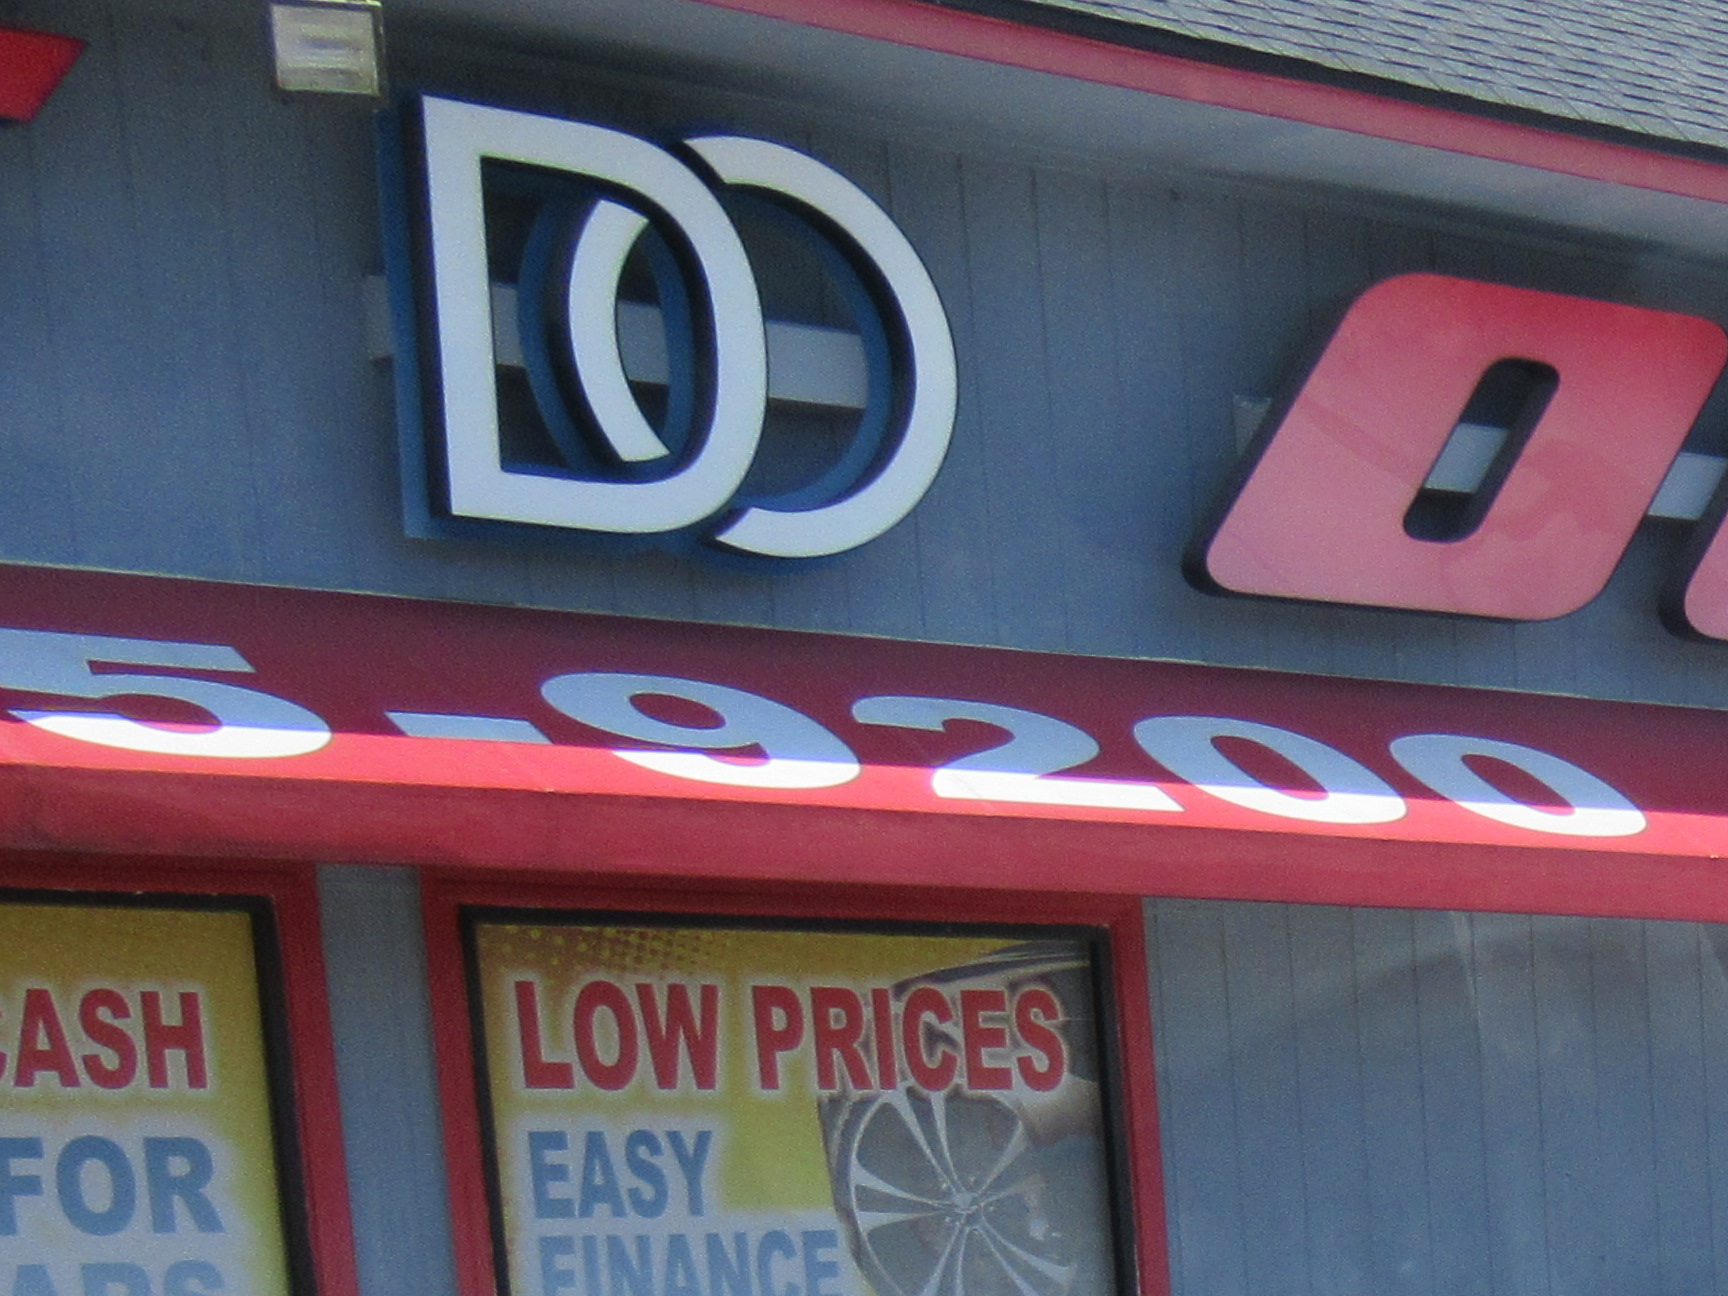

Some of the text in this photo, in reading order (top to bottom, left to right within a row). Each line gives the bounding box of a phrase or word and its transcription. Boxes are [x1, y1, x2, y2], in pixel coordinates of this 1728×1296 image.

[0, 988, 209, 1090] ASH
[514, 980, 1067, 1093] LOW PRICES
[0, 1135, 227, 1237] FOR
[527, 1128, 713, 1221] EASY
